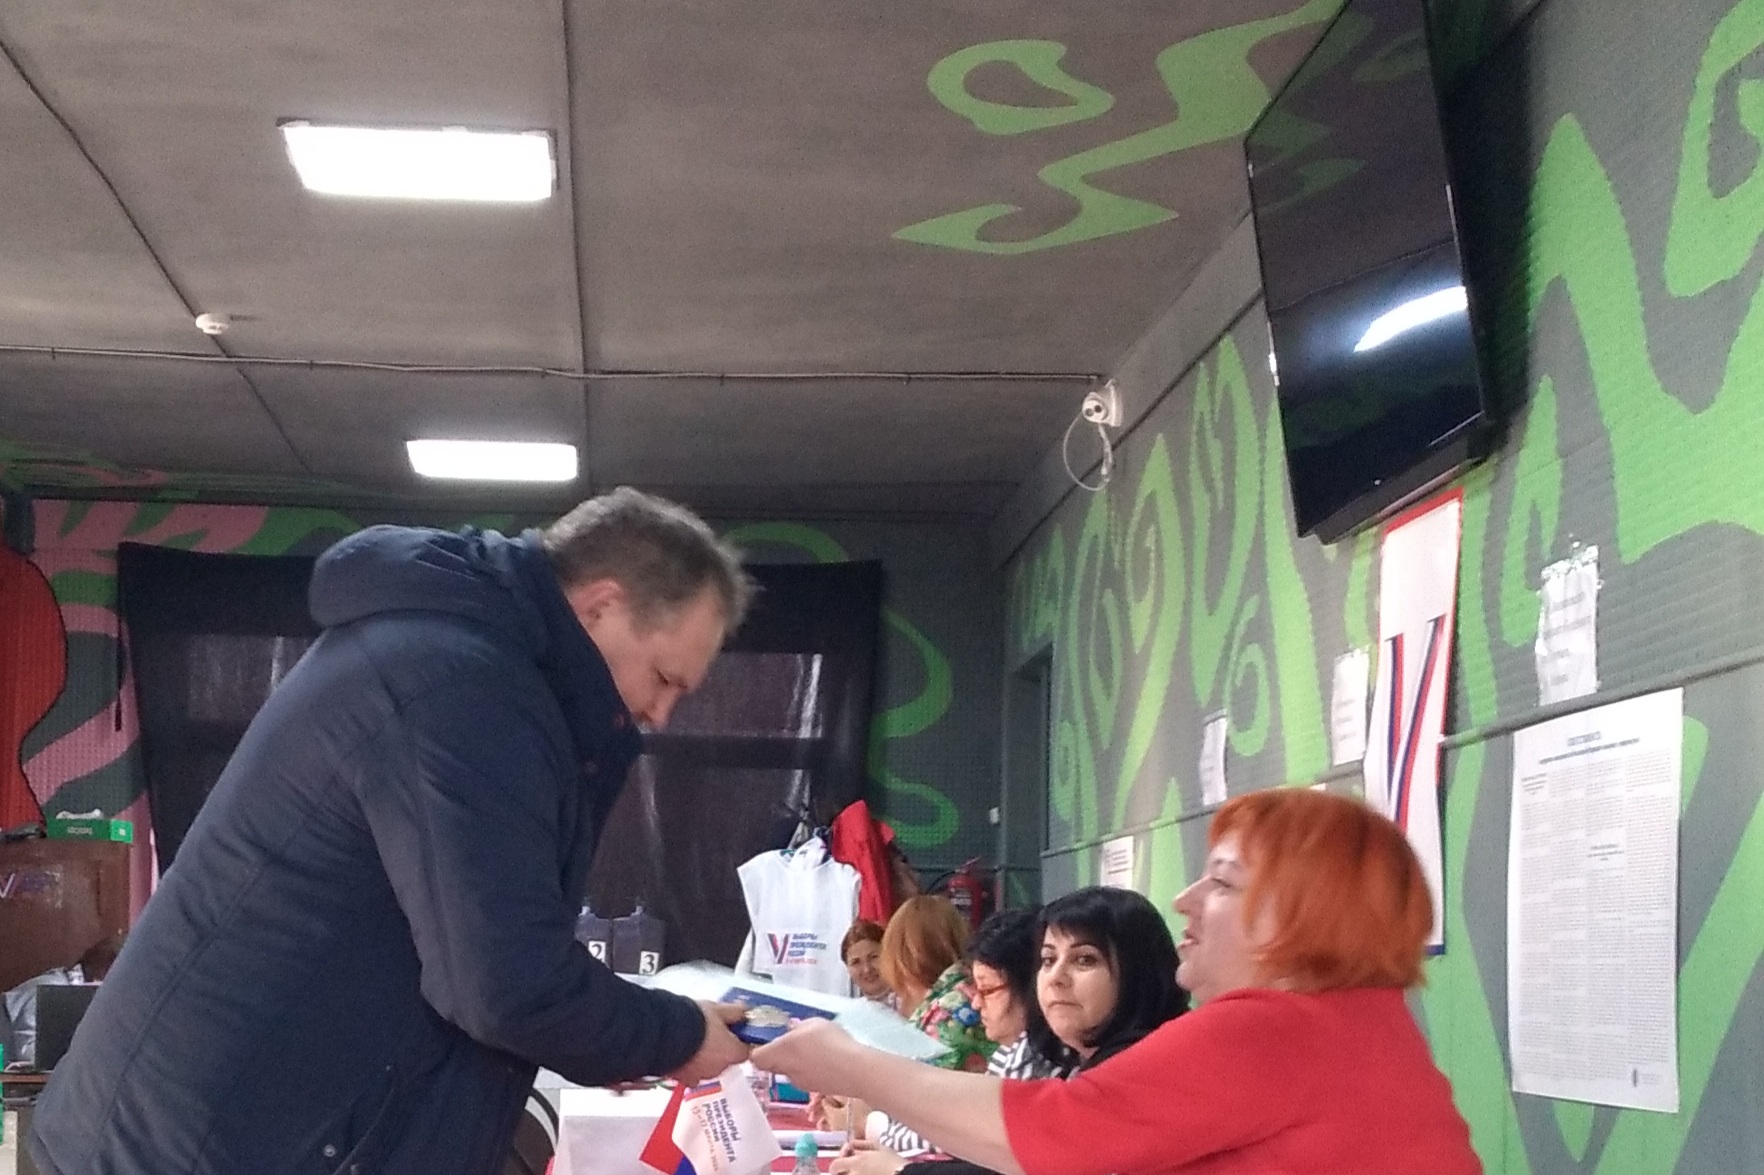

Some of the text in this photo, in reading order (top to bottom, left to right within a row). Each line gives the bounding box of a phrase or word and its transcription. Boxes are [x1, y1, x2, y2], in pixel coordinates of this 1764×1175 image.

[591, 943, 603, 958] 2
[642, 953, 656, 974] 3
[702, 1103, 720, 1142] РОССИИ
[712, 1100, 737, 1164] ПРЕЗИДЕНТА
[720, 1098, 742, 1142] ВЫБОРЫ
